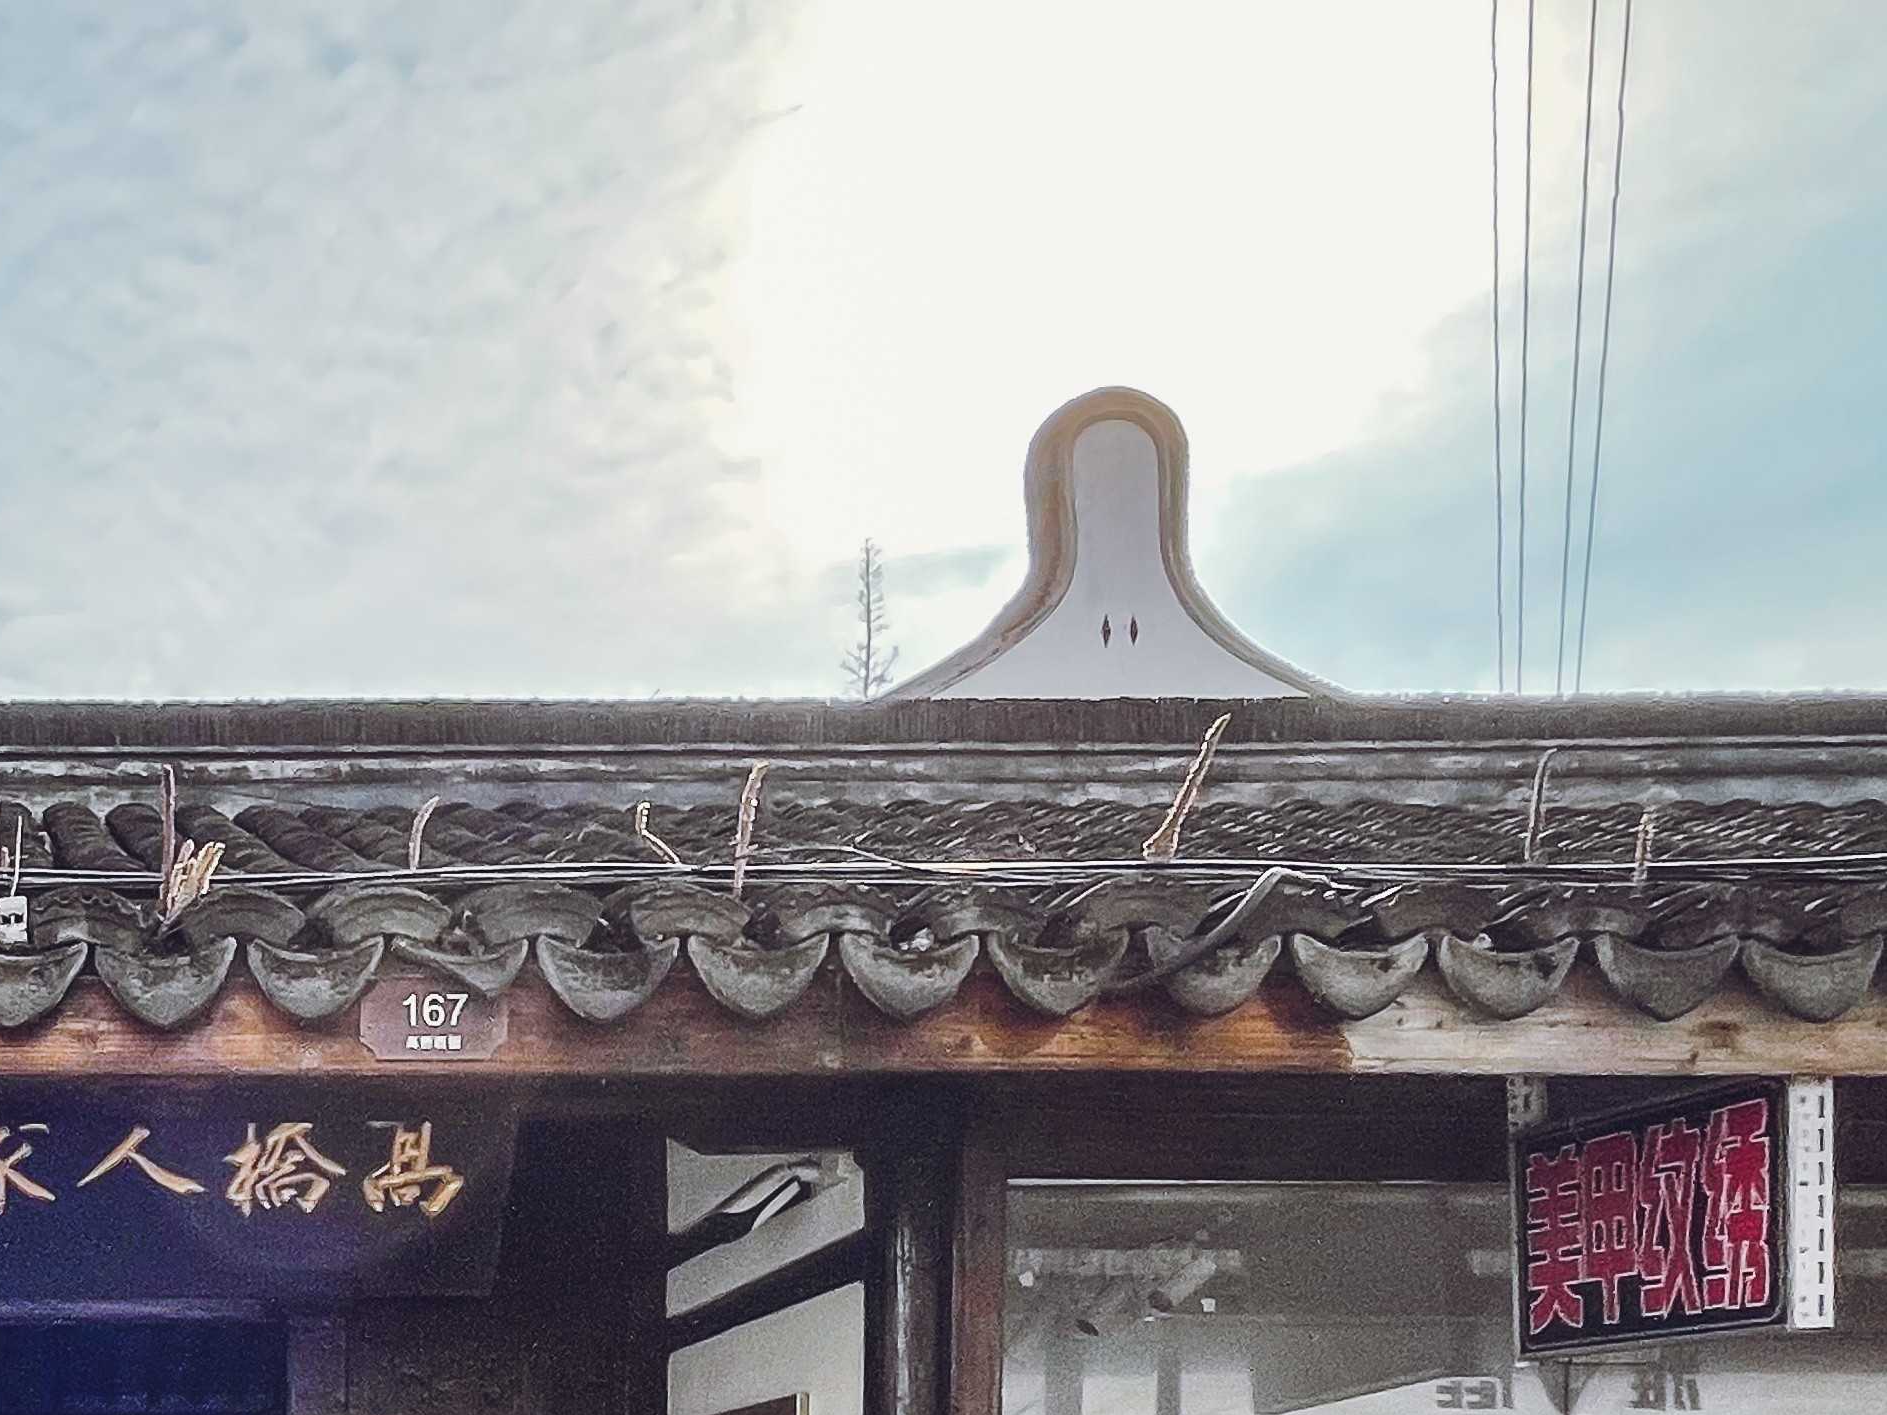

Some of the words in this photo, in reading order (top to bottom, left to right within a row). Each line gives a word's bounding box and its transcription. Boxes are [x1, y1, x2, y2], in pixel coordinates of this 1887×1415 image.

[402, 993, 469, 1028] 167
[1525, 1098, 1770, 1335] 美甲纹绣
